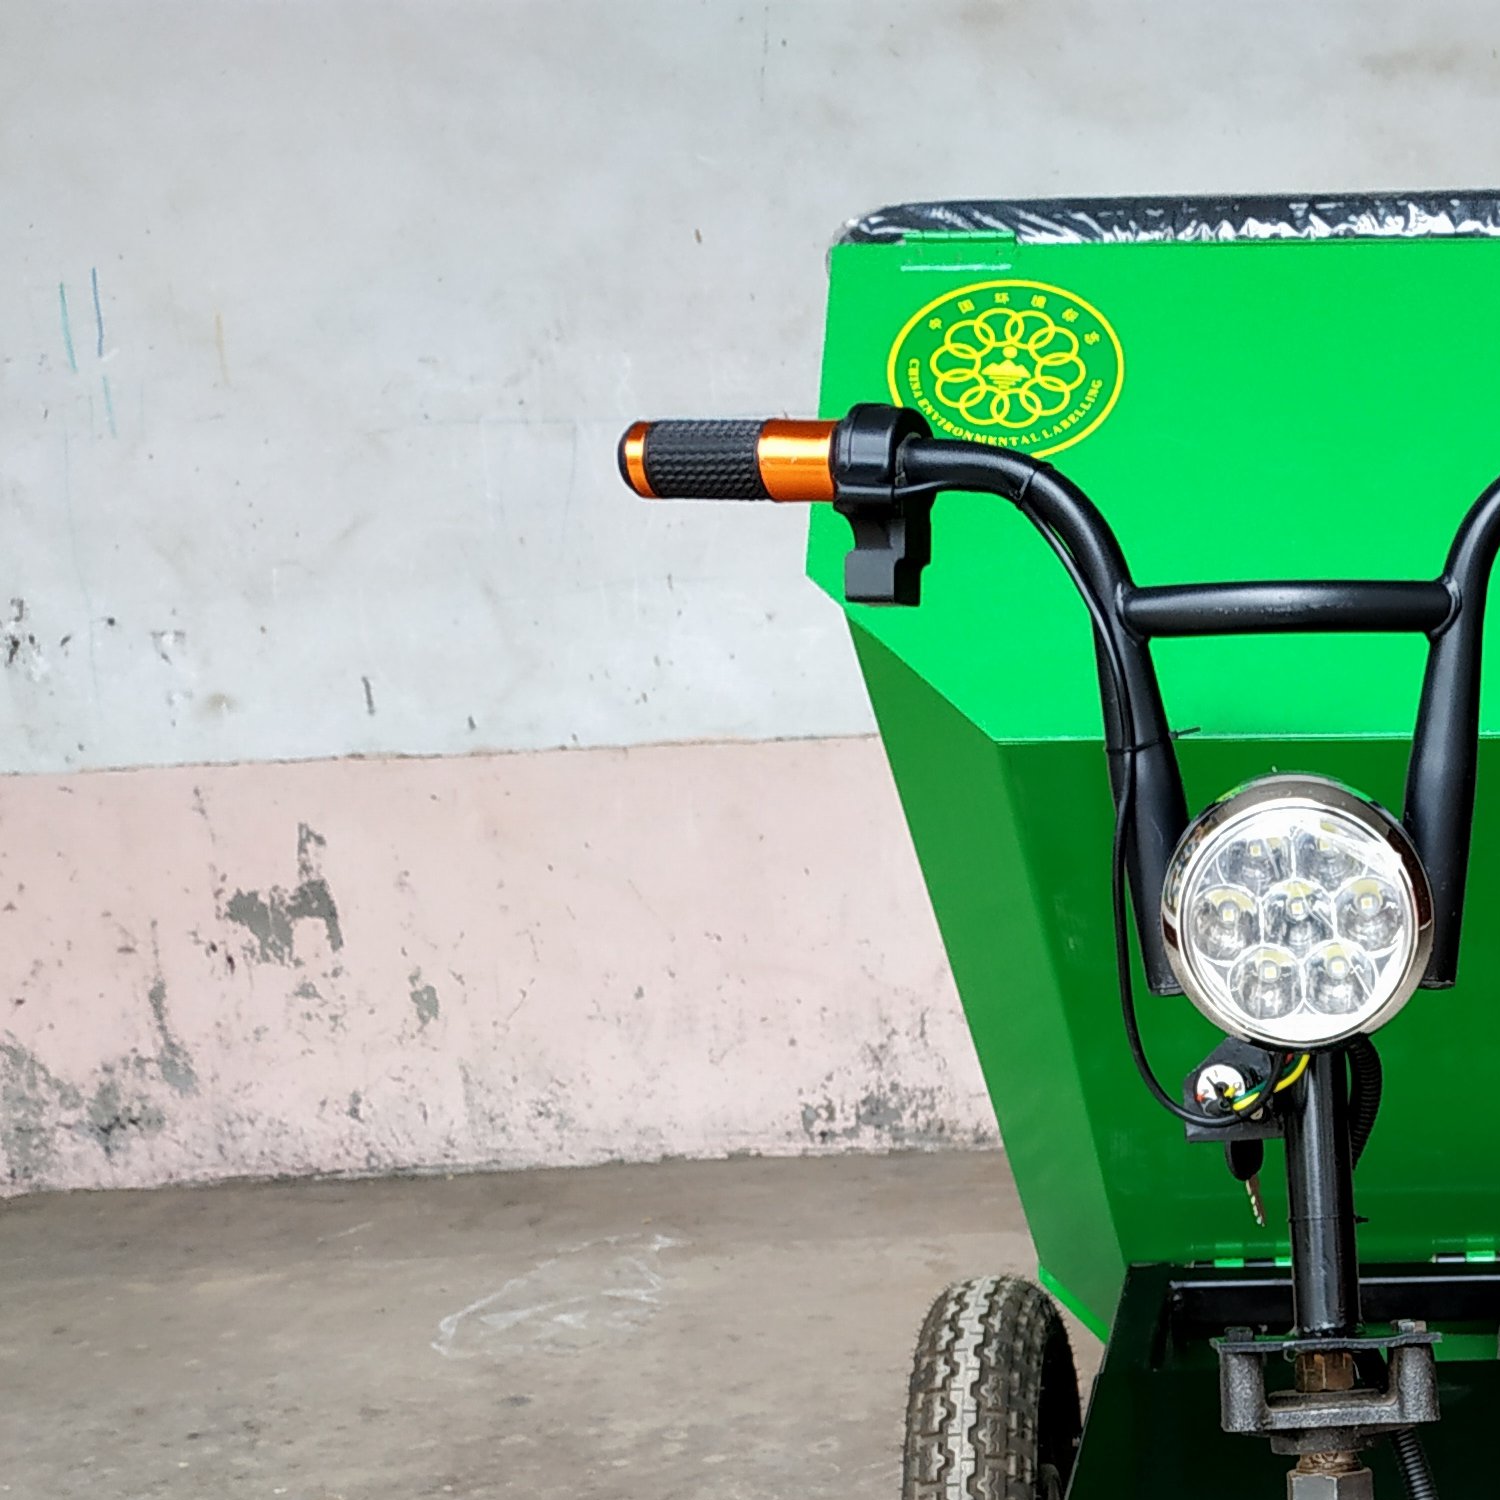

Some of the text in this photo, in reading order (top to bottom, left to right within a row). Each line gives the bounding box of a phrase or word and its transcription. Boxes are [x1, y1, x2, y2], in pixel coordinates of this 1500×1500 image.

[908, 358, 1103, 447] CHINA ENVIRONMENTAL LABELLING
